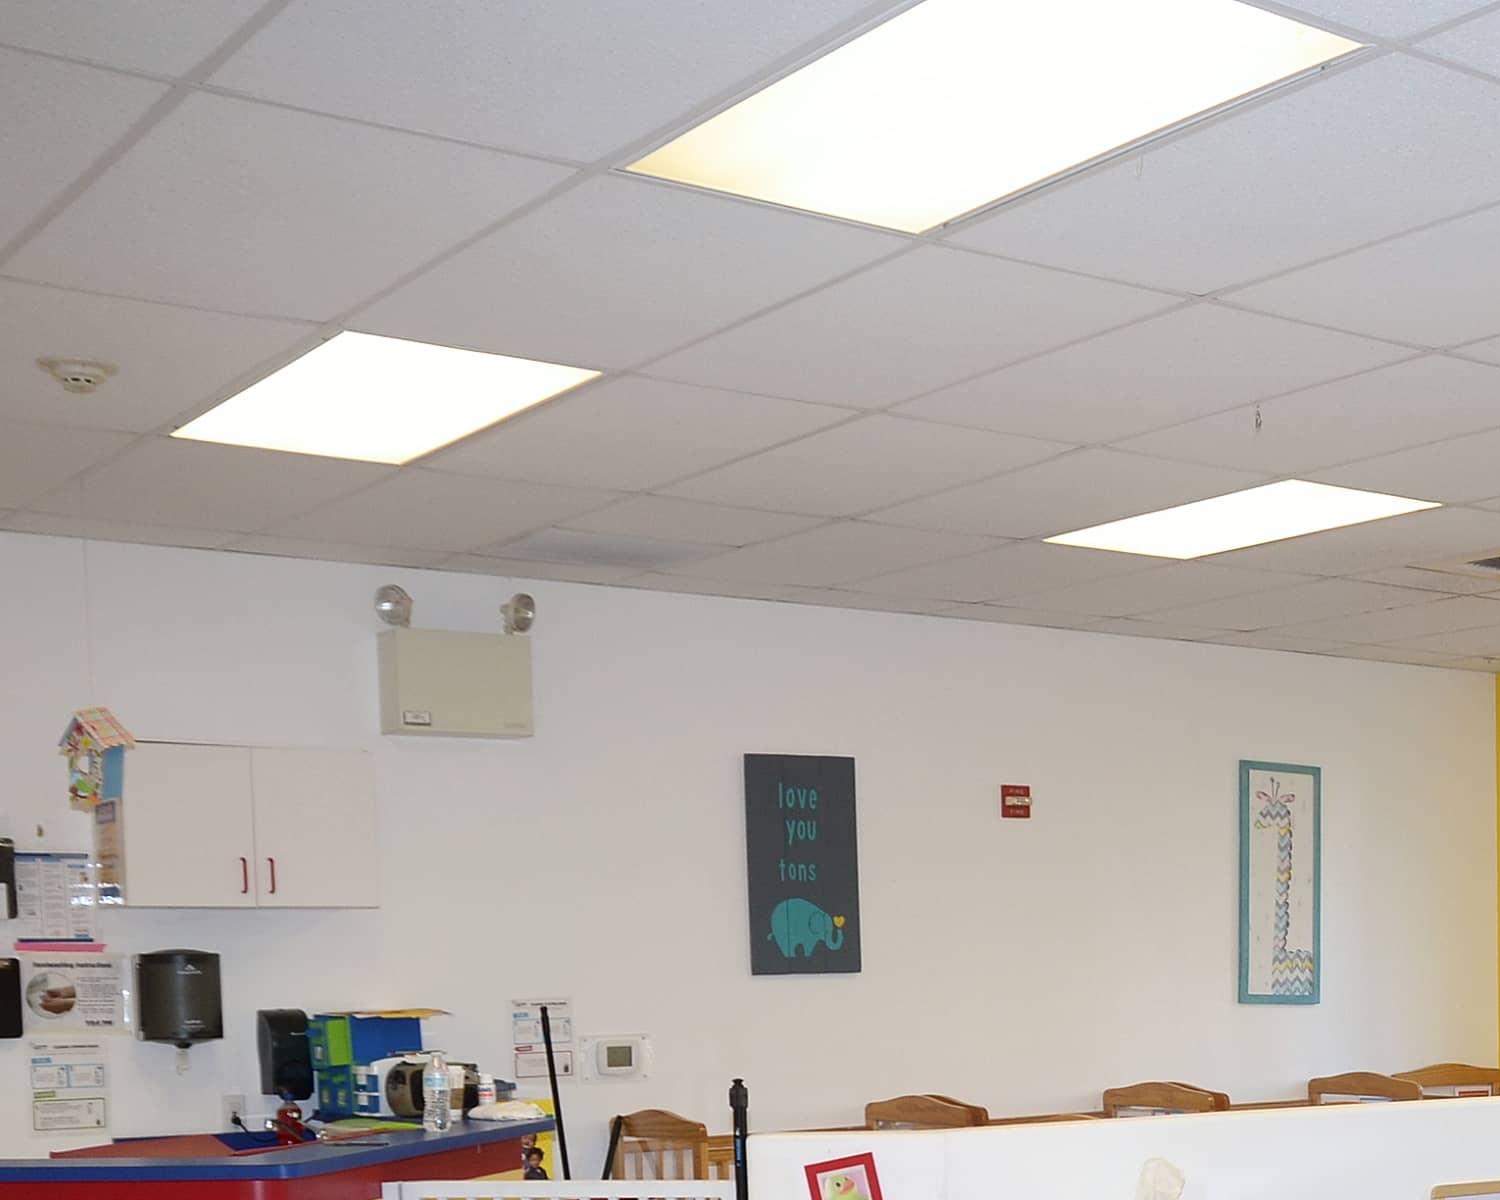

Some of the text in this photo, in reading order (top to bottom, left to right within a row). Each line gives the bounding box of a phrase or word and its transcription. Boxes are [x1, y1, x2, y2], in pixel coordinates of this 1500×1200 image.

[778, 782, 817, 809] love
[785, 819, 817, 847] you
[778, 858, 817, 881] tons
